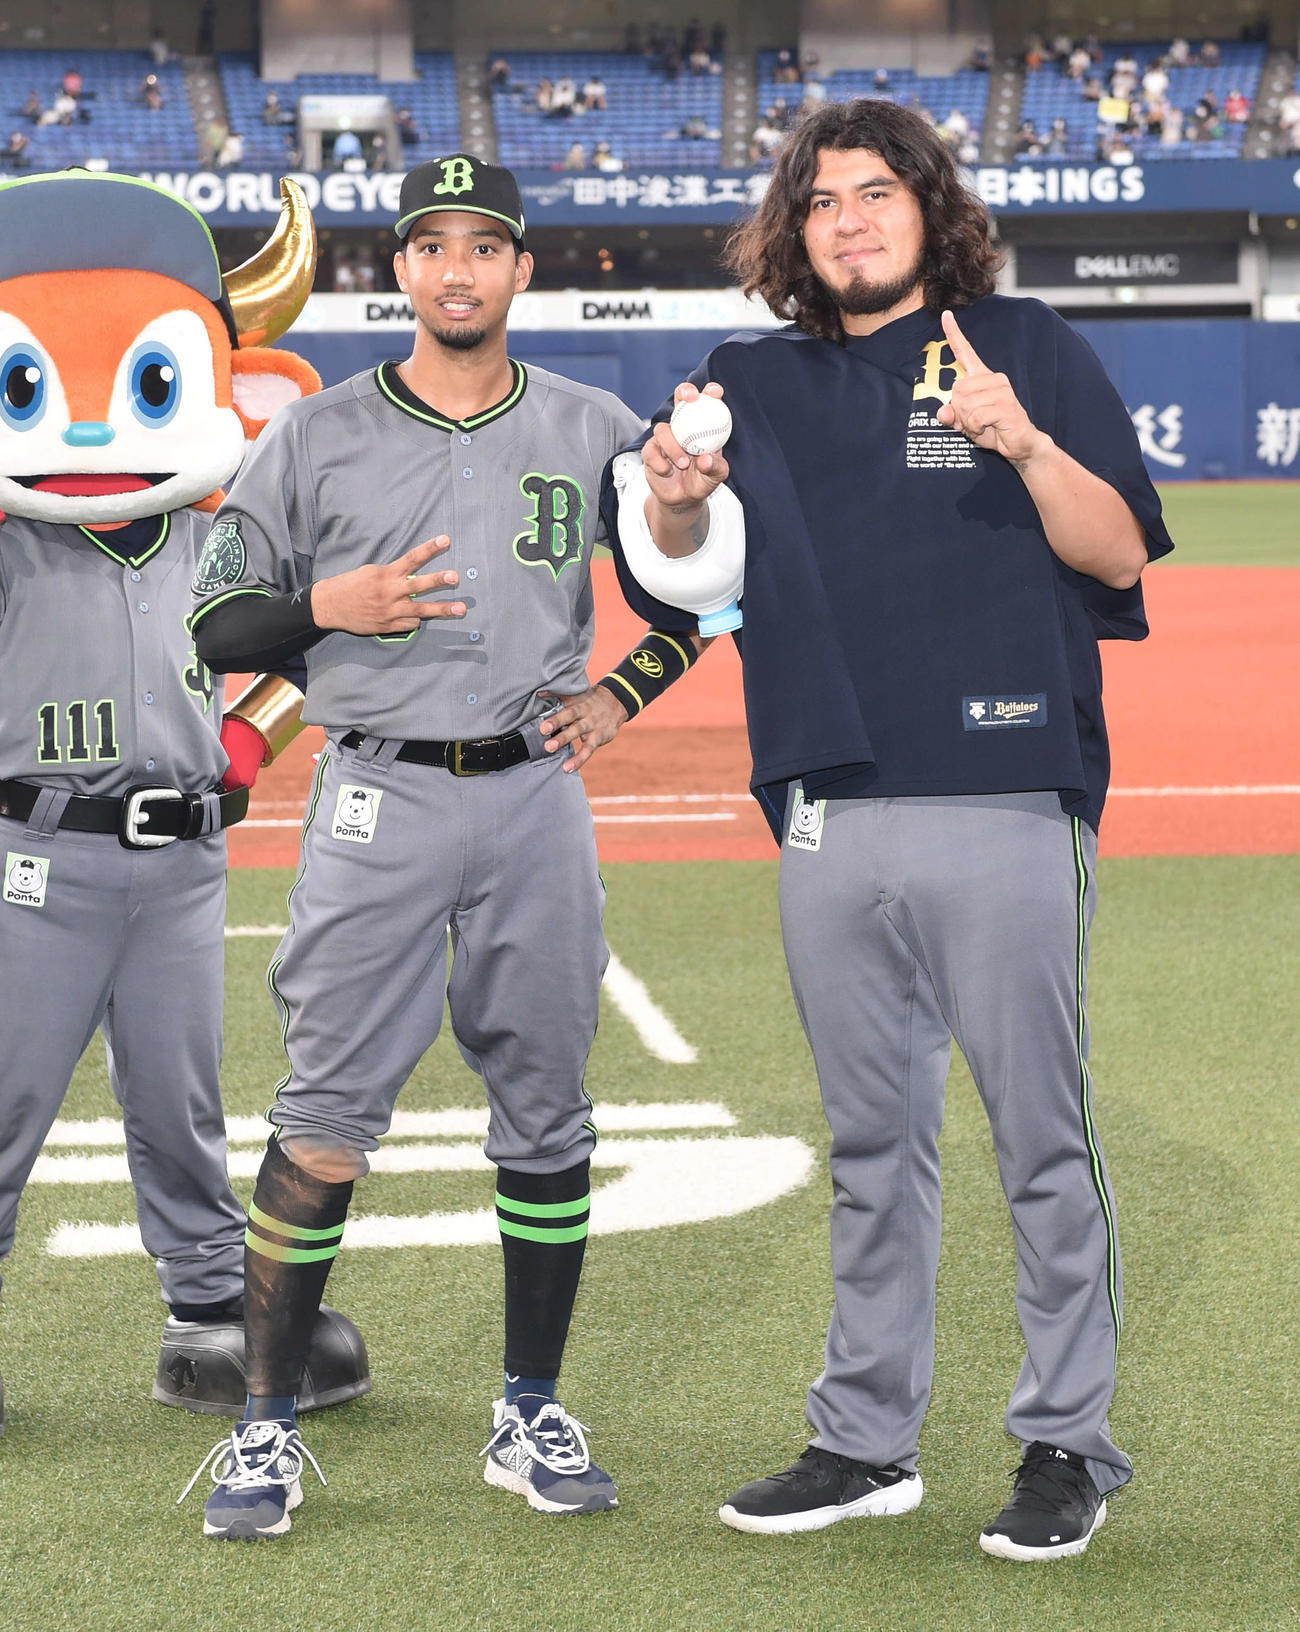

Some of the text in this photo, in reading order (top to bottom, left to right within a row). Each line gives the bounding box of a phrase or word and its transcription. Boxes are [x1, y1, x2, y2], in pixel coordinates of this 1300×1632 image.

[433, 157, 474, 196] B
[512, 471, 586, 583] B
[37, 699, 120, 764] 111
[335, 825, 370, 839] Ponta
[790, 832, 818, 847] Ponta
[7, 890, 41, 904] Ponta
